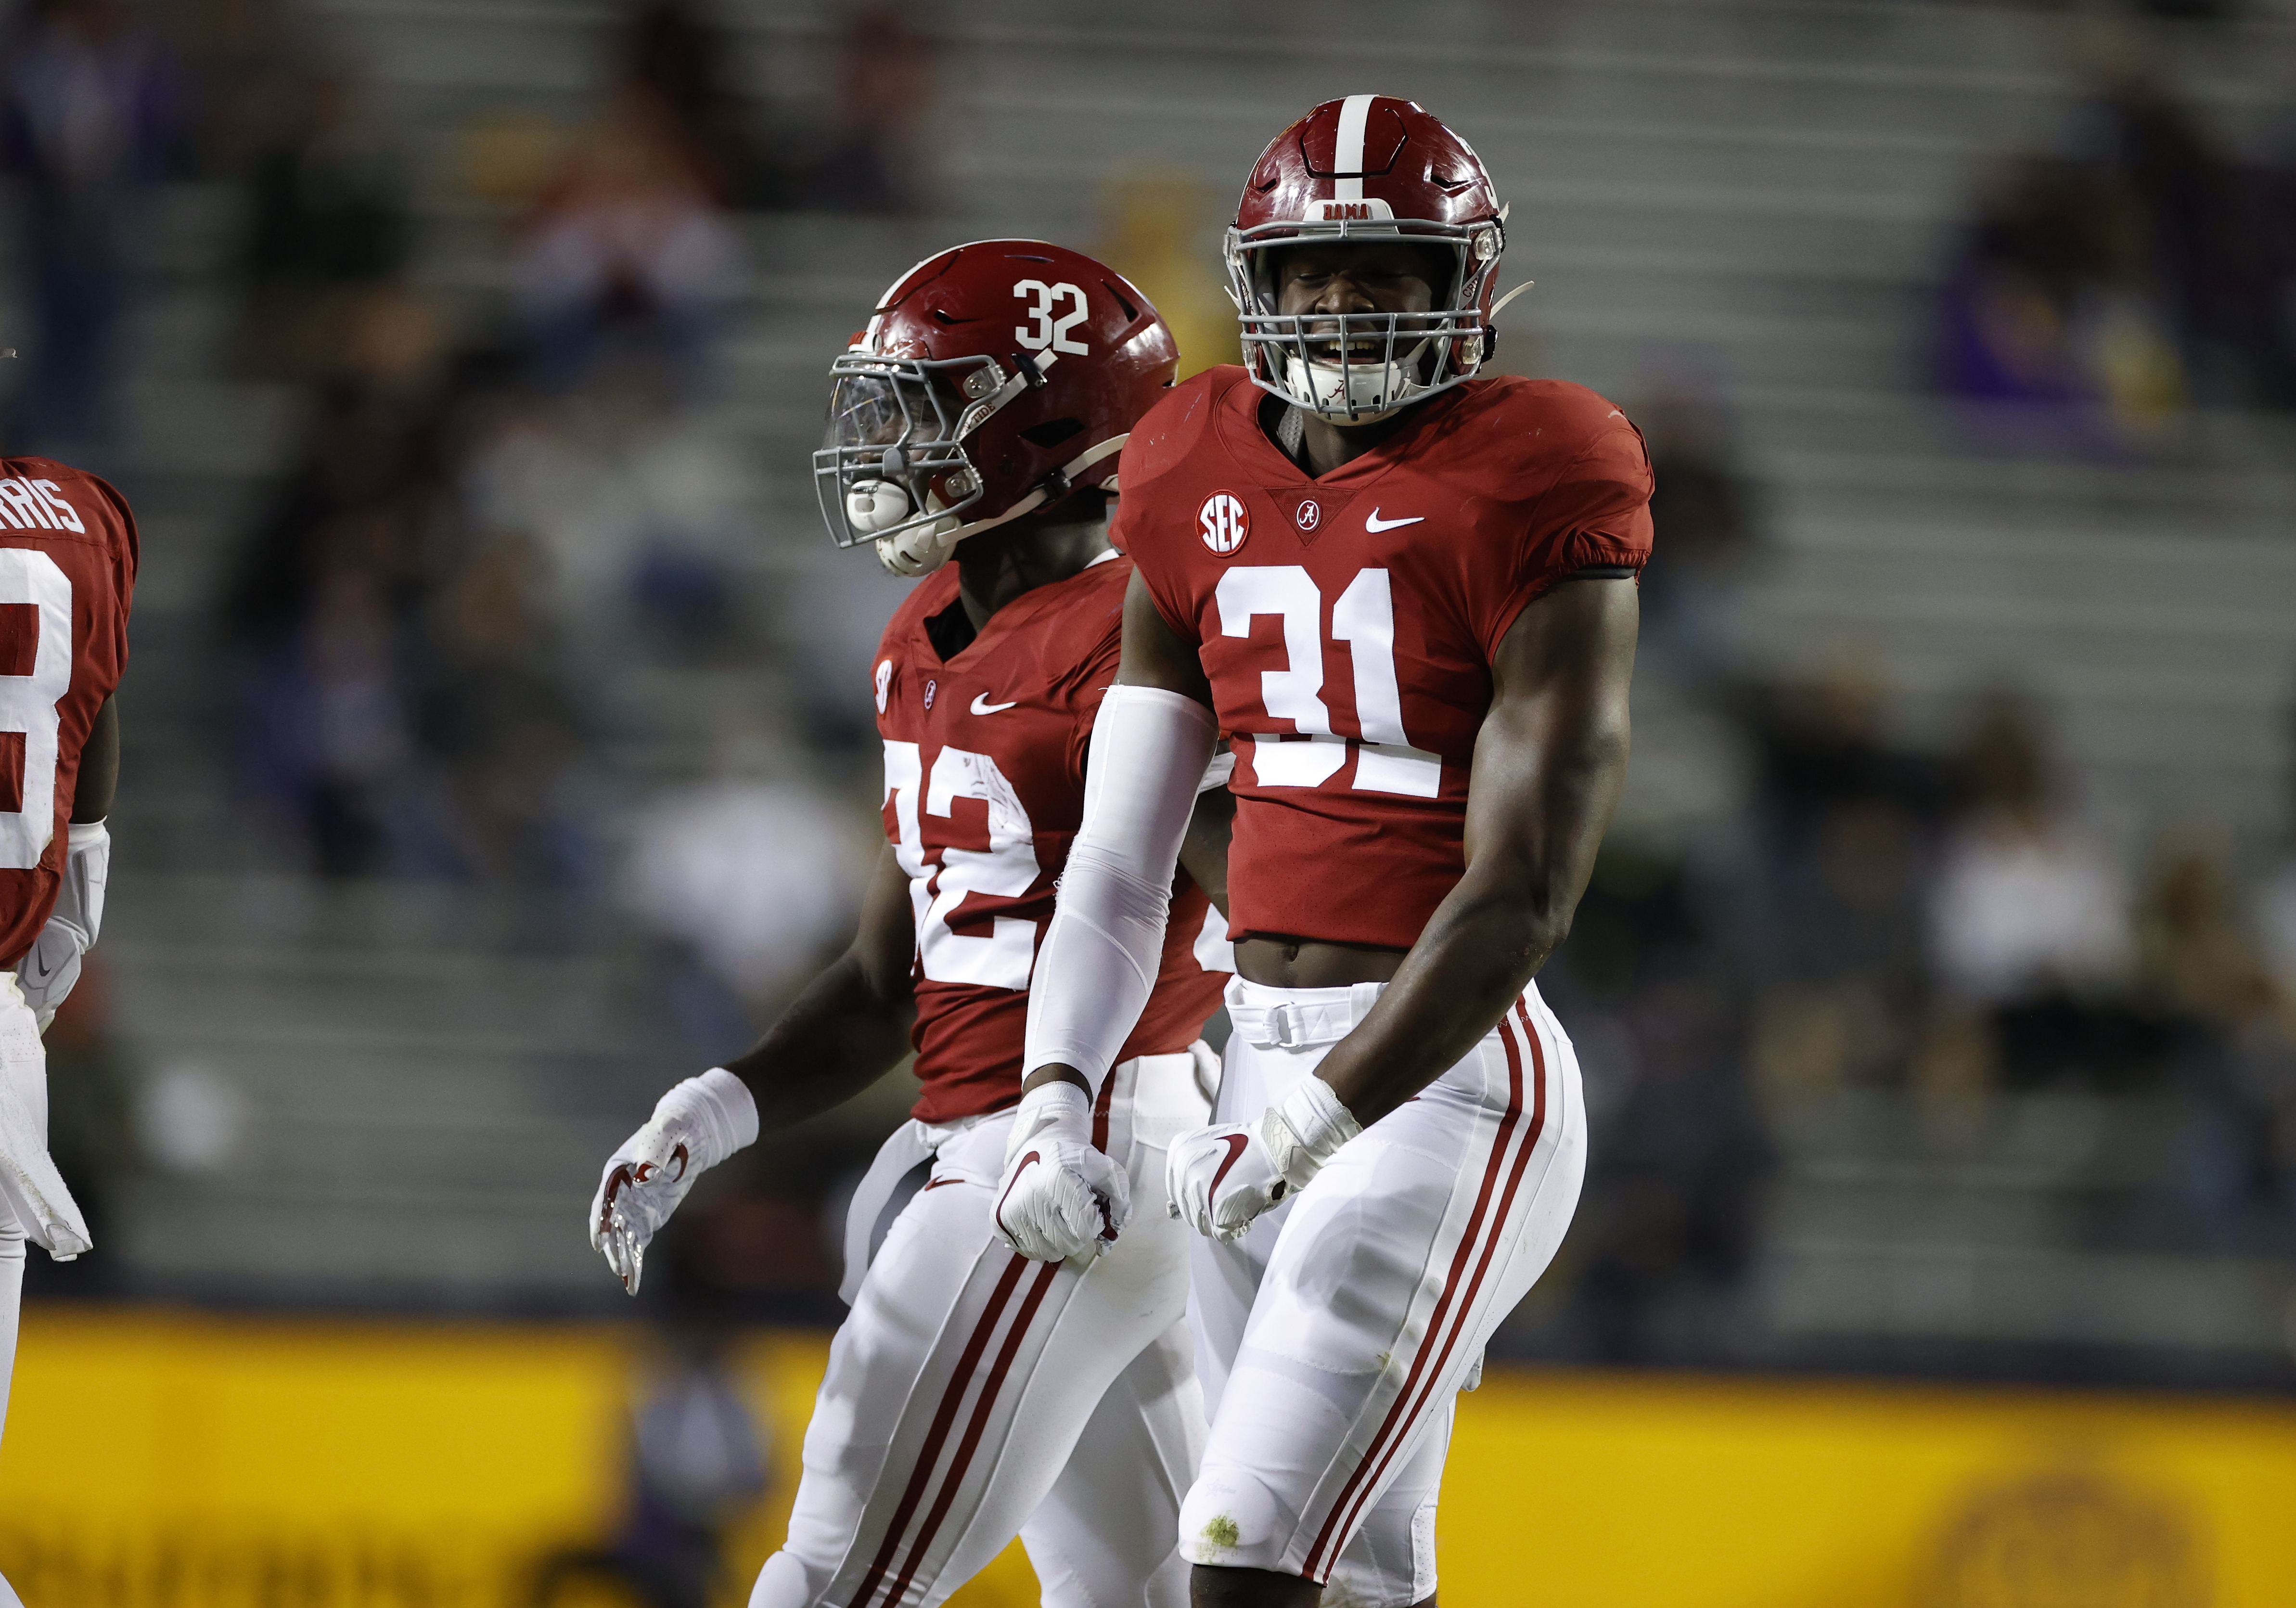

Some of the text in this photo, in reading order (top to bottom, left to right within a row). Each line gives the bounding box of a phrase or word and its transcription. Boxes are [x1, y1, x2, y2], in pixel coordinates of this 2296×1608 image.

[1323, 203, 1368, 220] BAMA
[1013, 279, 1089, 356] 32
[1200, 494, 1244, 553] SEC
[1215, 565, 1442, 799] 31
